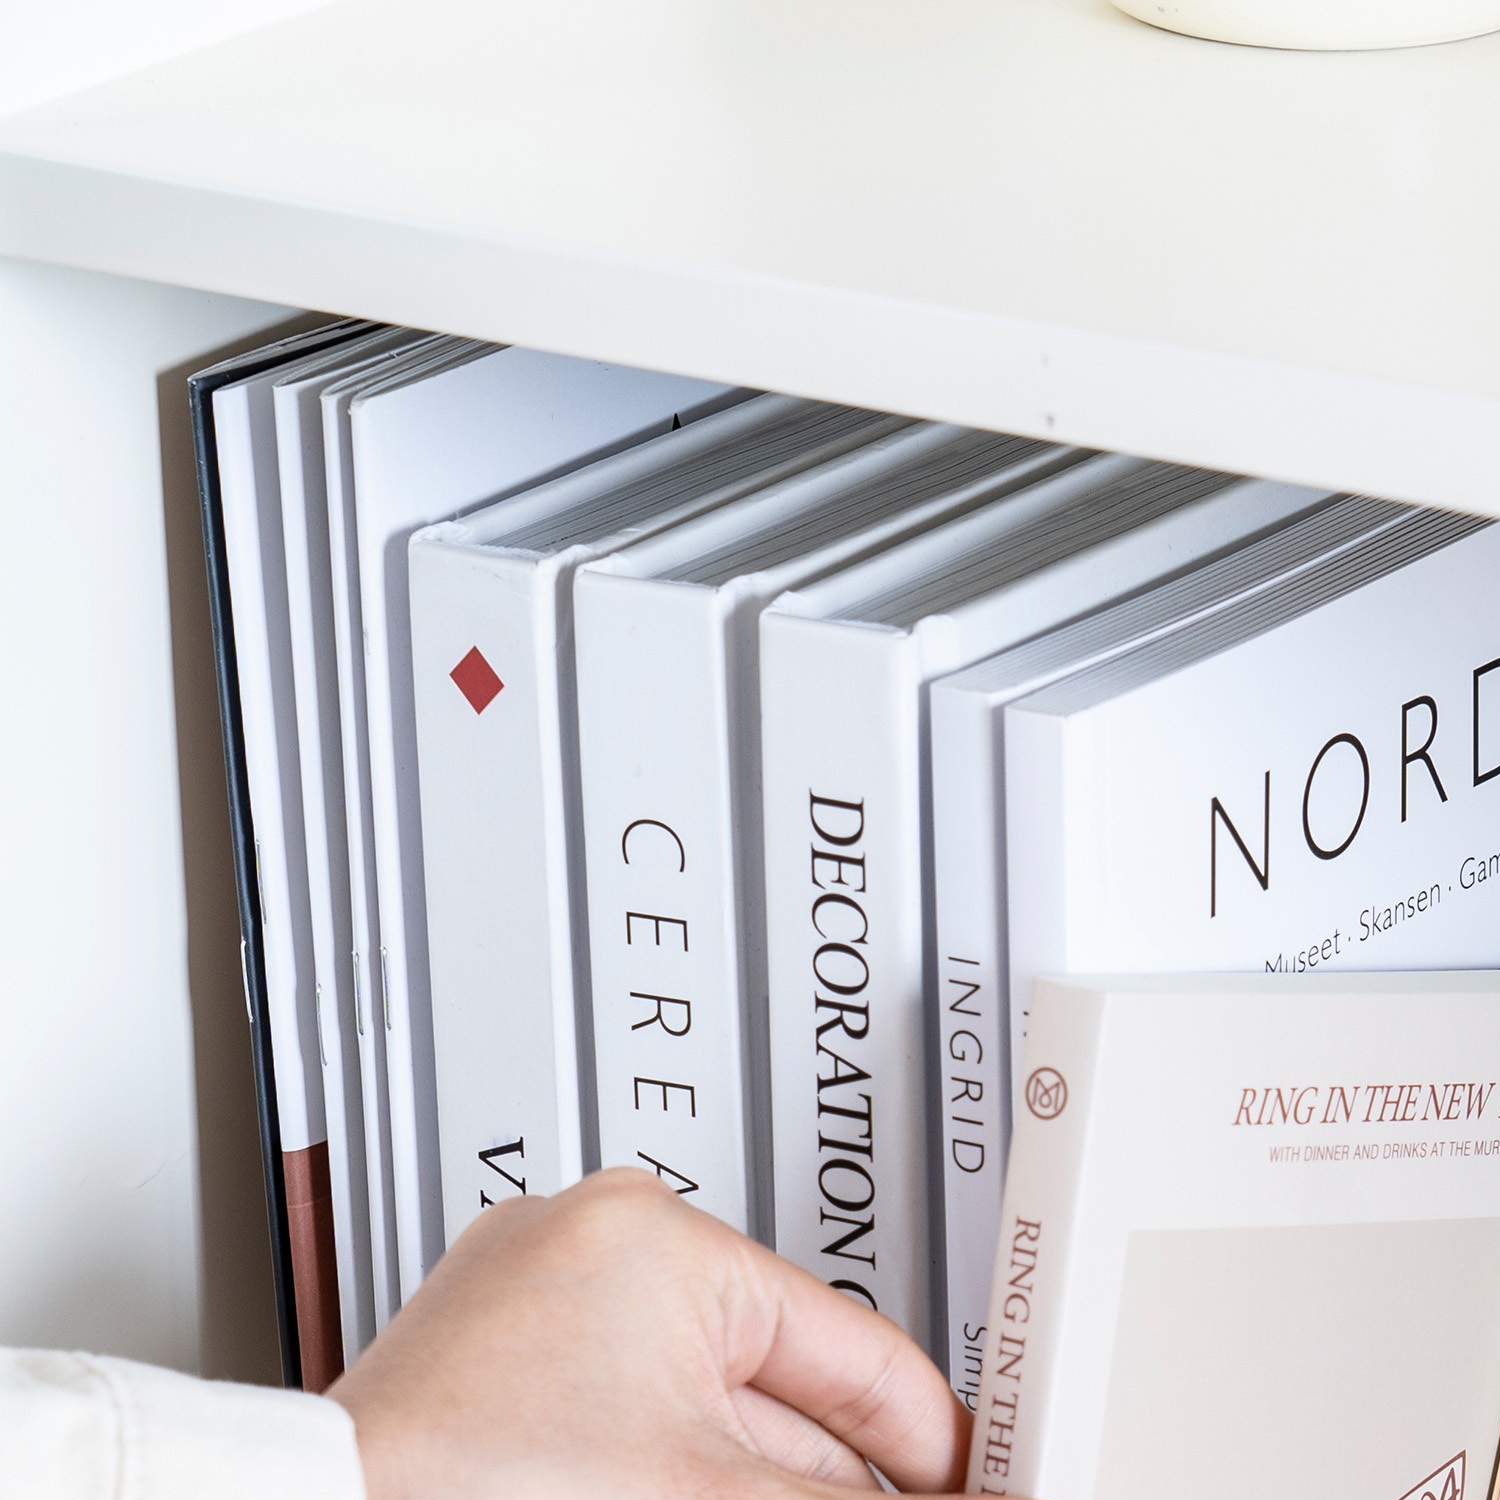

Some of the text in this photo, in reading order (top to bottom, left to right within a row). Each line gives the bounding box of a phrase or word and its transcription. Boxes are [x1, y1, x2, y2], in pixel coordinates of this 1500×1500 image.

[1359, 883, 1441, 941] Skansen
[808, 787, 876, 1271] DECORATION
[948, 956, 985, 1174] INGRID
[1231, 1087, 1318, 1126] RING
[1320, 1086, 1361, 1124] IN
[1362, 1084, 1421, 1122] THE
[1421, 1082, 1496, 1120] NEW
[1269, 1145, 1300, 1162] WITH
[1304, 1144, 1350, 1161] DINNER
[1353, 1143, 1379, 1160] AND
[1382, 1142, 1427, 1159] DRINKS
[1430, 1141, 1447, 1157] AT
[1449, 1140, 1471, 1156] THE
[1004, 1215, 1042, 1324] RING
[996, 1332, 1026, 1383] IN
[983, 1393, 1019, 1478] THE
